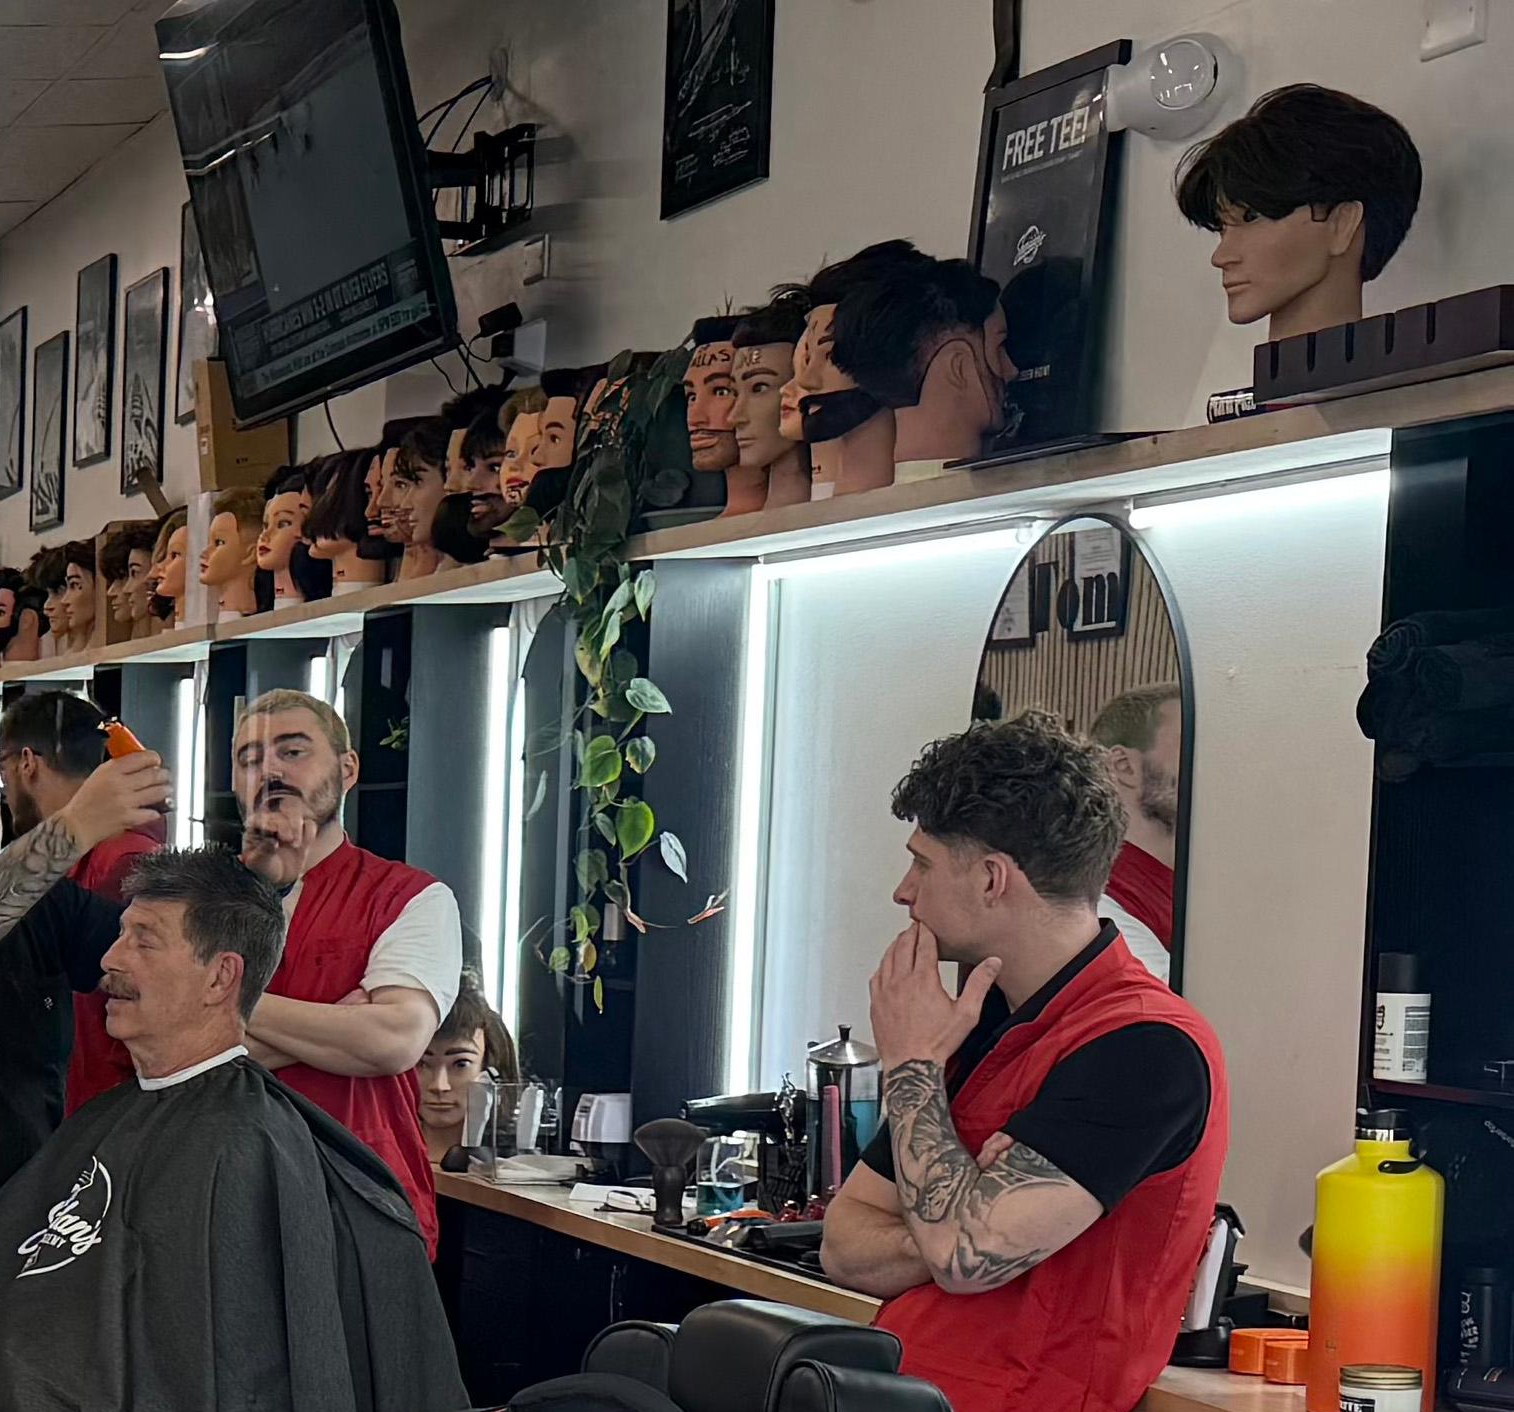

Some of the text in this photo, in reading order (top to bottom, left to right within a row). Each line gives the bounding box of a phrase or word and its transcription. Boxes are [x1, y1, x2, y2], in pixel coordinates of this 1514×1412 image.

[1002, 106, 1090, 170] FREE TEE!
[1035, 562, 1119, 633] Tom
